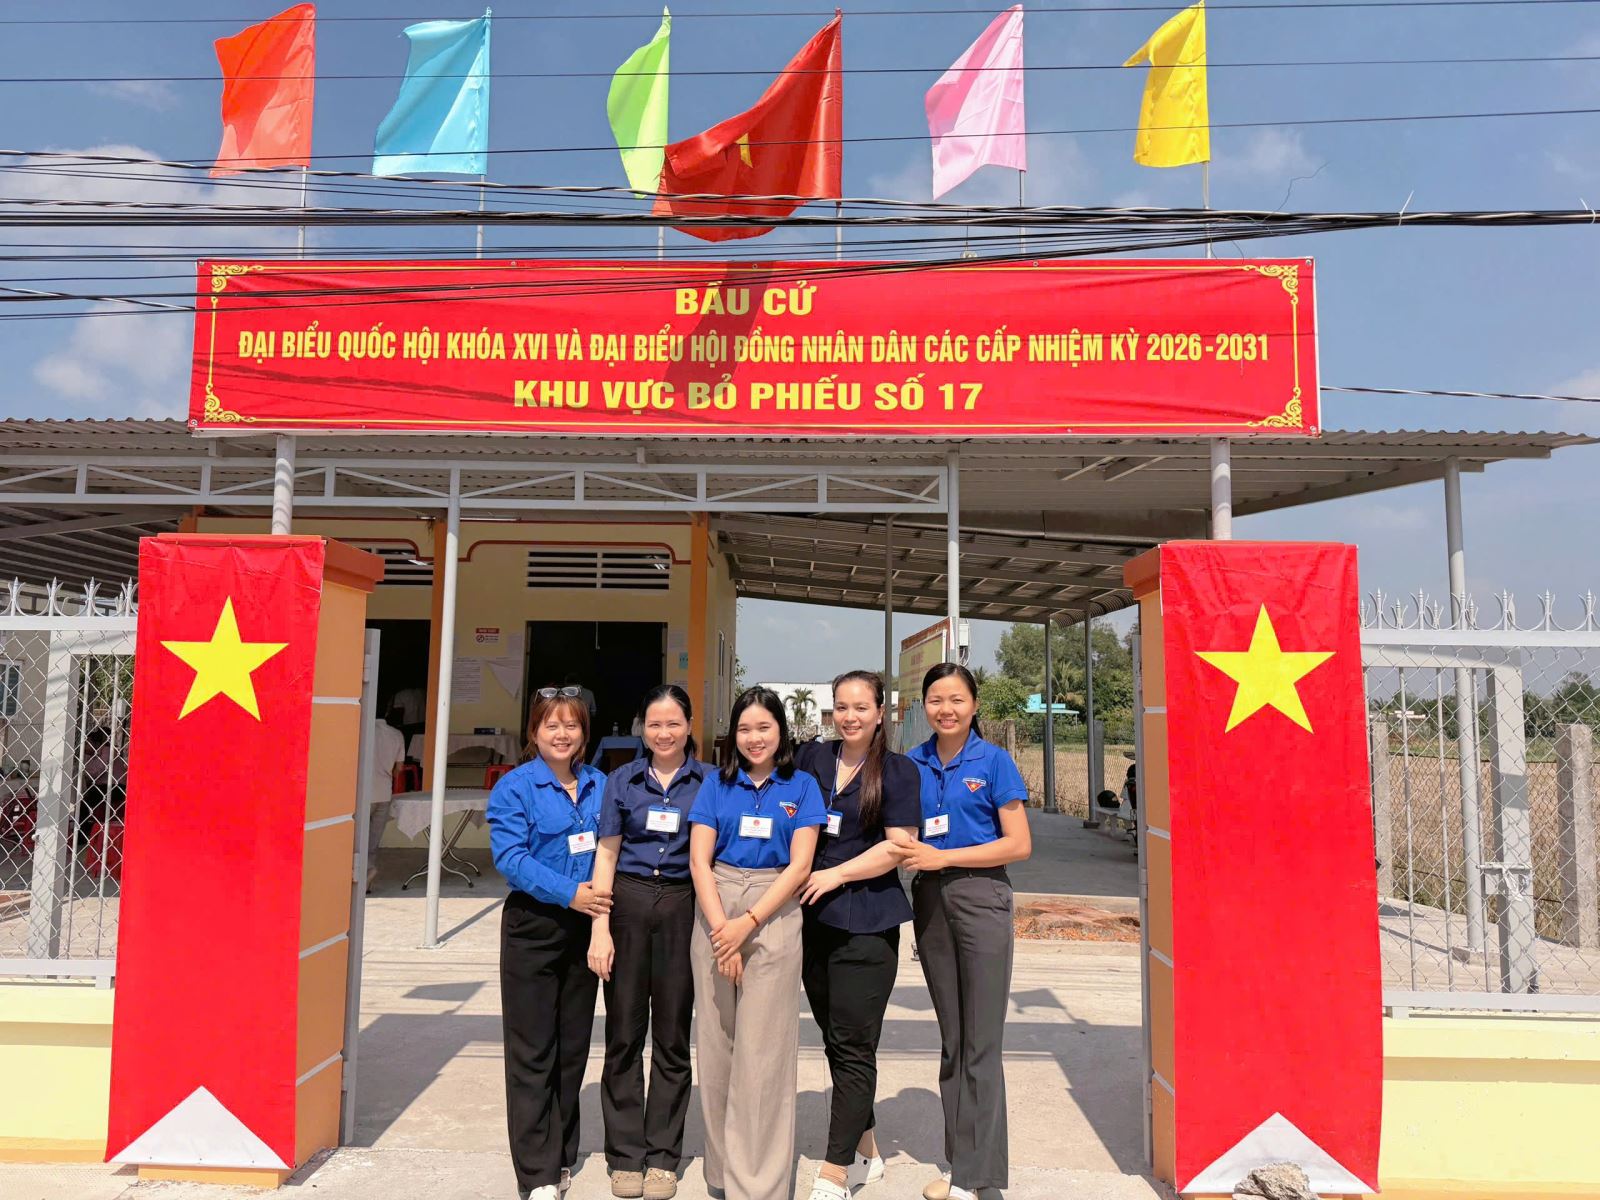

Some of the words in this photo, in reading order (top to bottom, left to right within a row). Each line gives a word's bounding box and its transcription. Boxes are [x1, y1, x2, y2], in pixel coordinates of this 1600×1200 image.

[763, 279, 818, 315] CỬ
[238, 331, 276, 365] ĐẠI
[282, 320, 331, 359] BIỂU
[338, 322, 396, 362] QUỐC
[403, 327, 440, 365] HỘI
[447, 328, 507, 360] KHÓA
[513, 333, 548, 361] XVI
[555, 328, 584, 361] VÀ
[590, 334, 627, 368] ĐẠI
[634, 323, 684, 362] BIỂU
[691, 330, 727, 368] HỘI
[734, 325, 795, 363] ĐỒNG
[802, 329, 864, 363] NHÂN
[871, 329, 918, 363] DÂN
[924, 329, 969, 363] CÁC
[976, 325, 1021, 363] CẤP
[1029, 328, 1103, 368] NHIỆM
[1111, 327, 1140, 361] KỲ
[514, 380, 589, 408] KHU
[601, 379, 674, 415] VỰC
[688, 373, 737, 410] BỎ
[751, 373, 861, 411] PHIẾU
[875, 372, 925, 411] SỐ
[938, 383, 984, 411] 17
